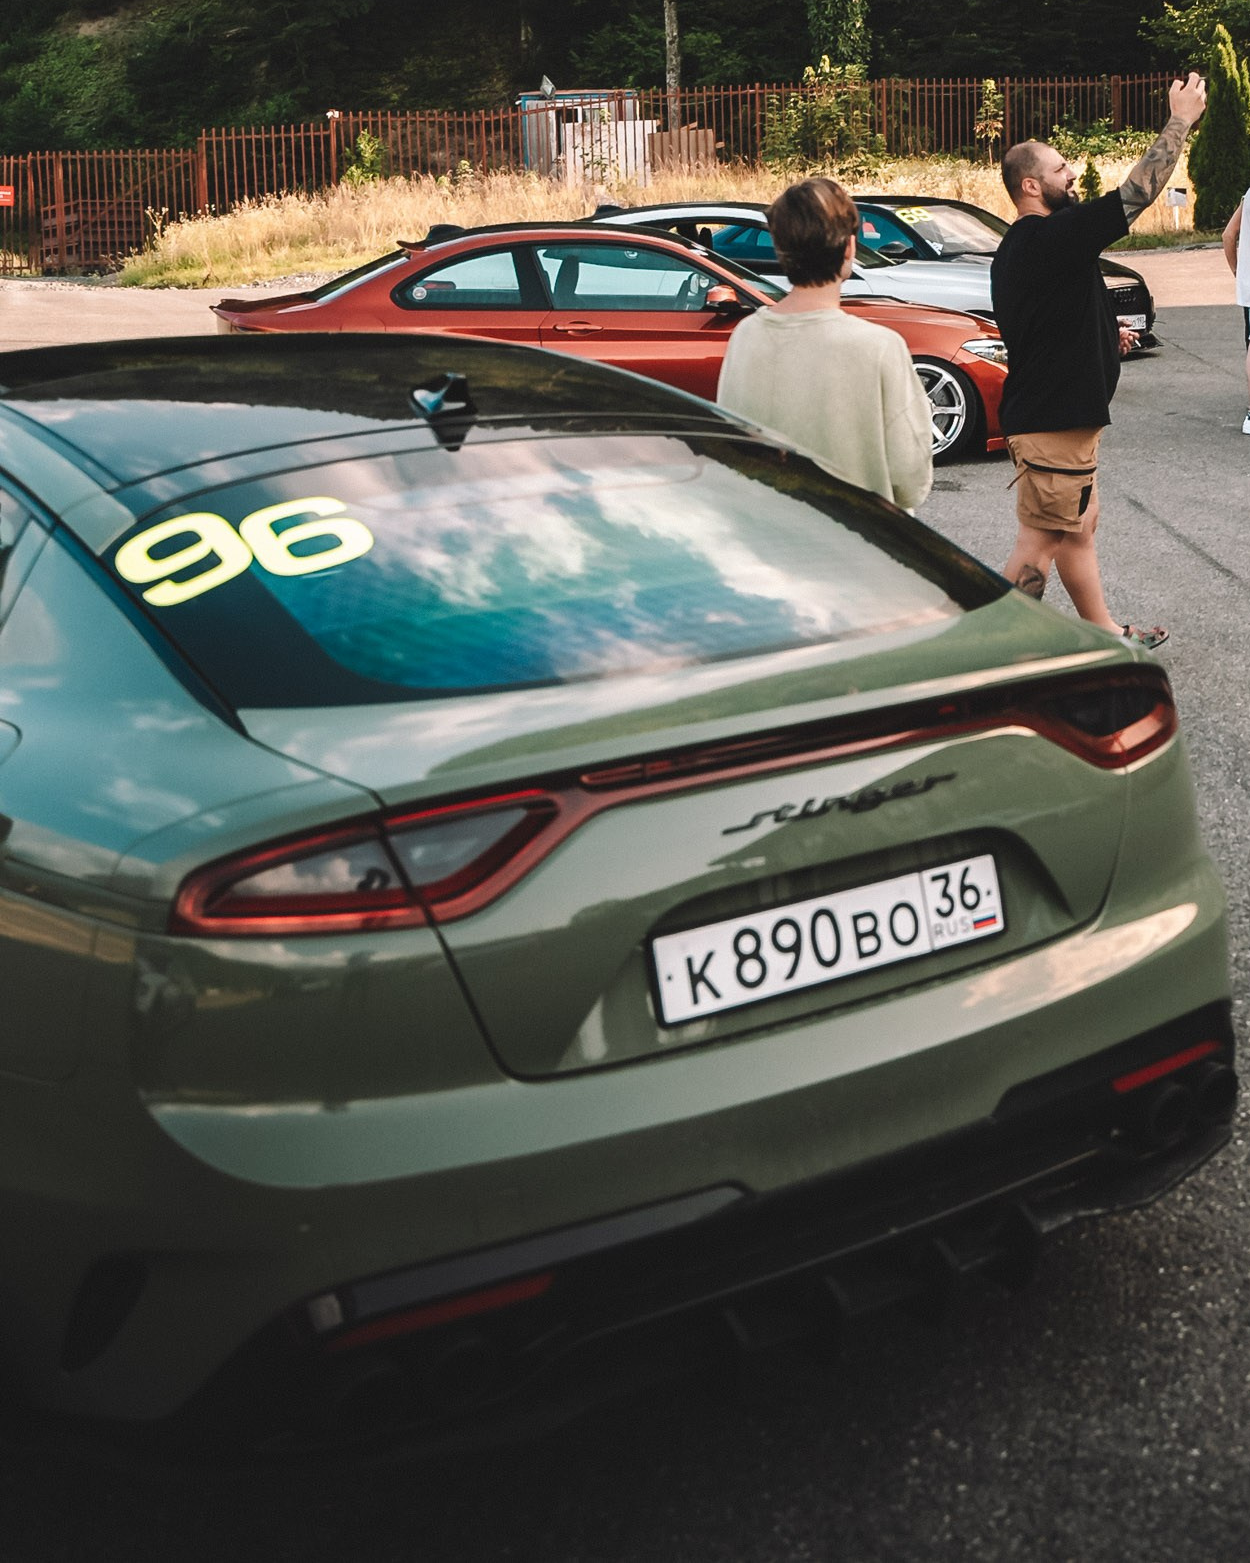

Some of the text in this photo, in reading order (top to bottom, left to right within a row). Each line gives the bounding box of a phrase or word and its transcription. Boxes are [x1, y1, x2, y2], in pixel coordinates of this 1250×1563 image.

[895, 207, 932, 224] 69
[114, 496, 375, 607] 96
[930, 866, 982, 919] 36
[932, 920, 972, 939] RUS
